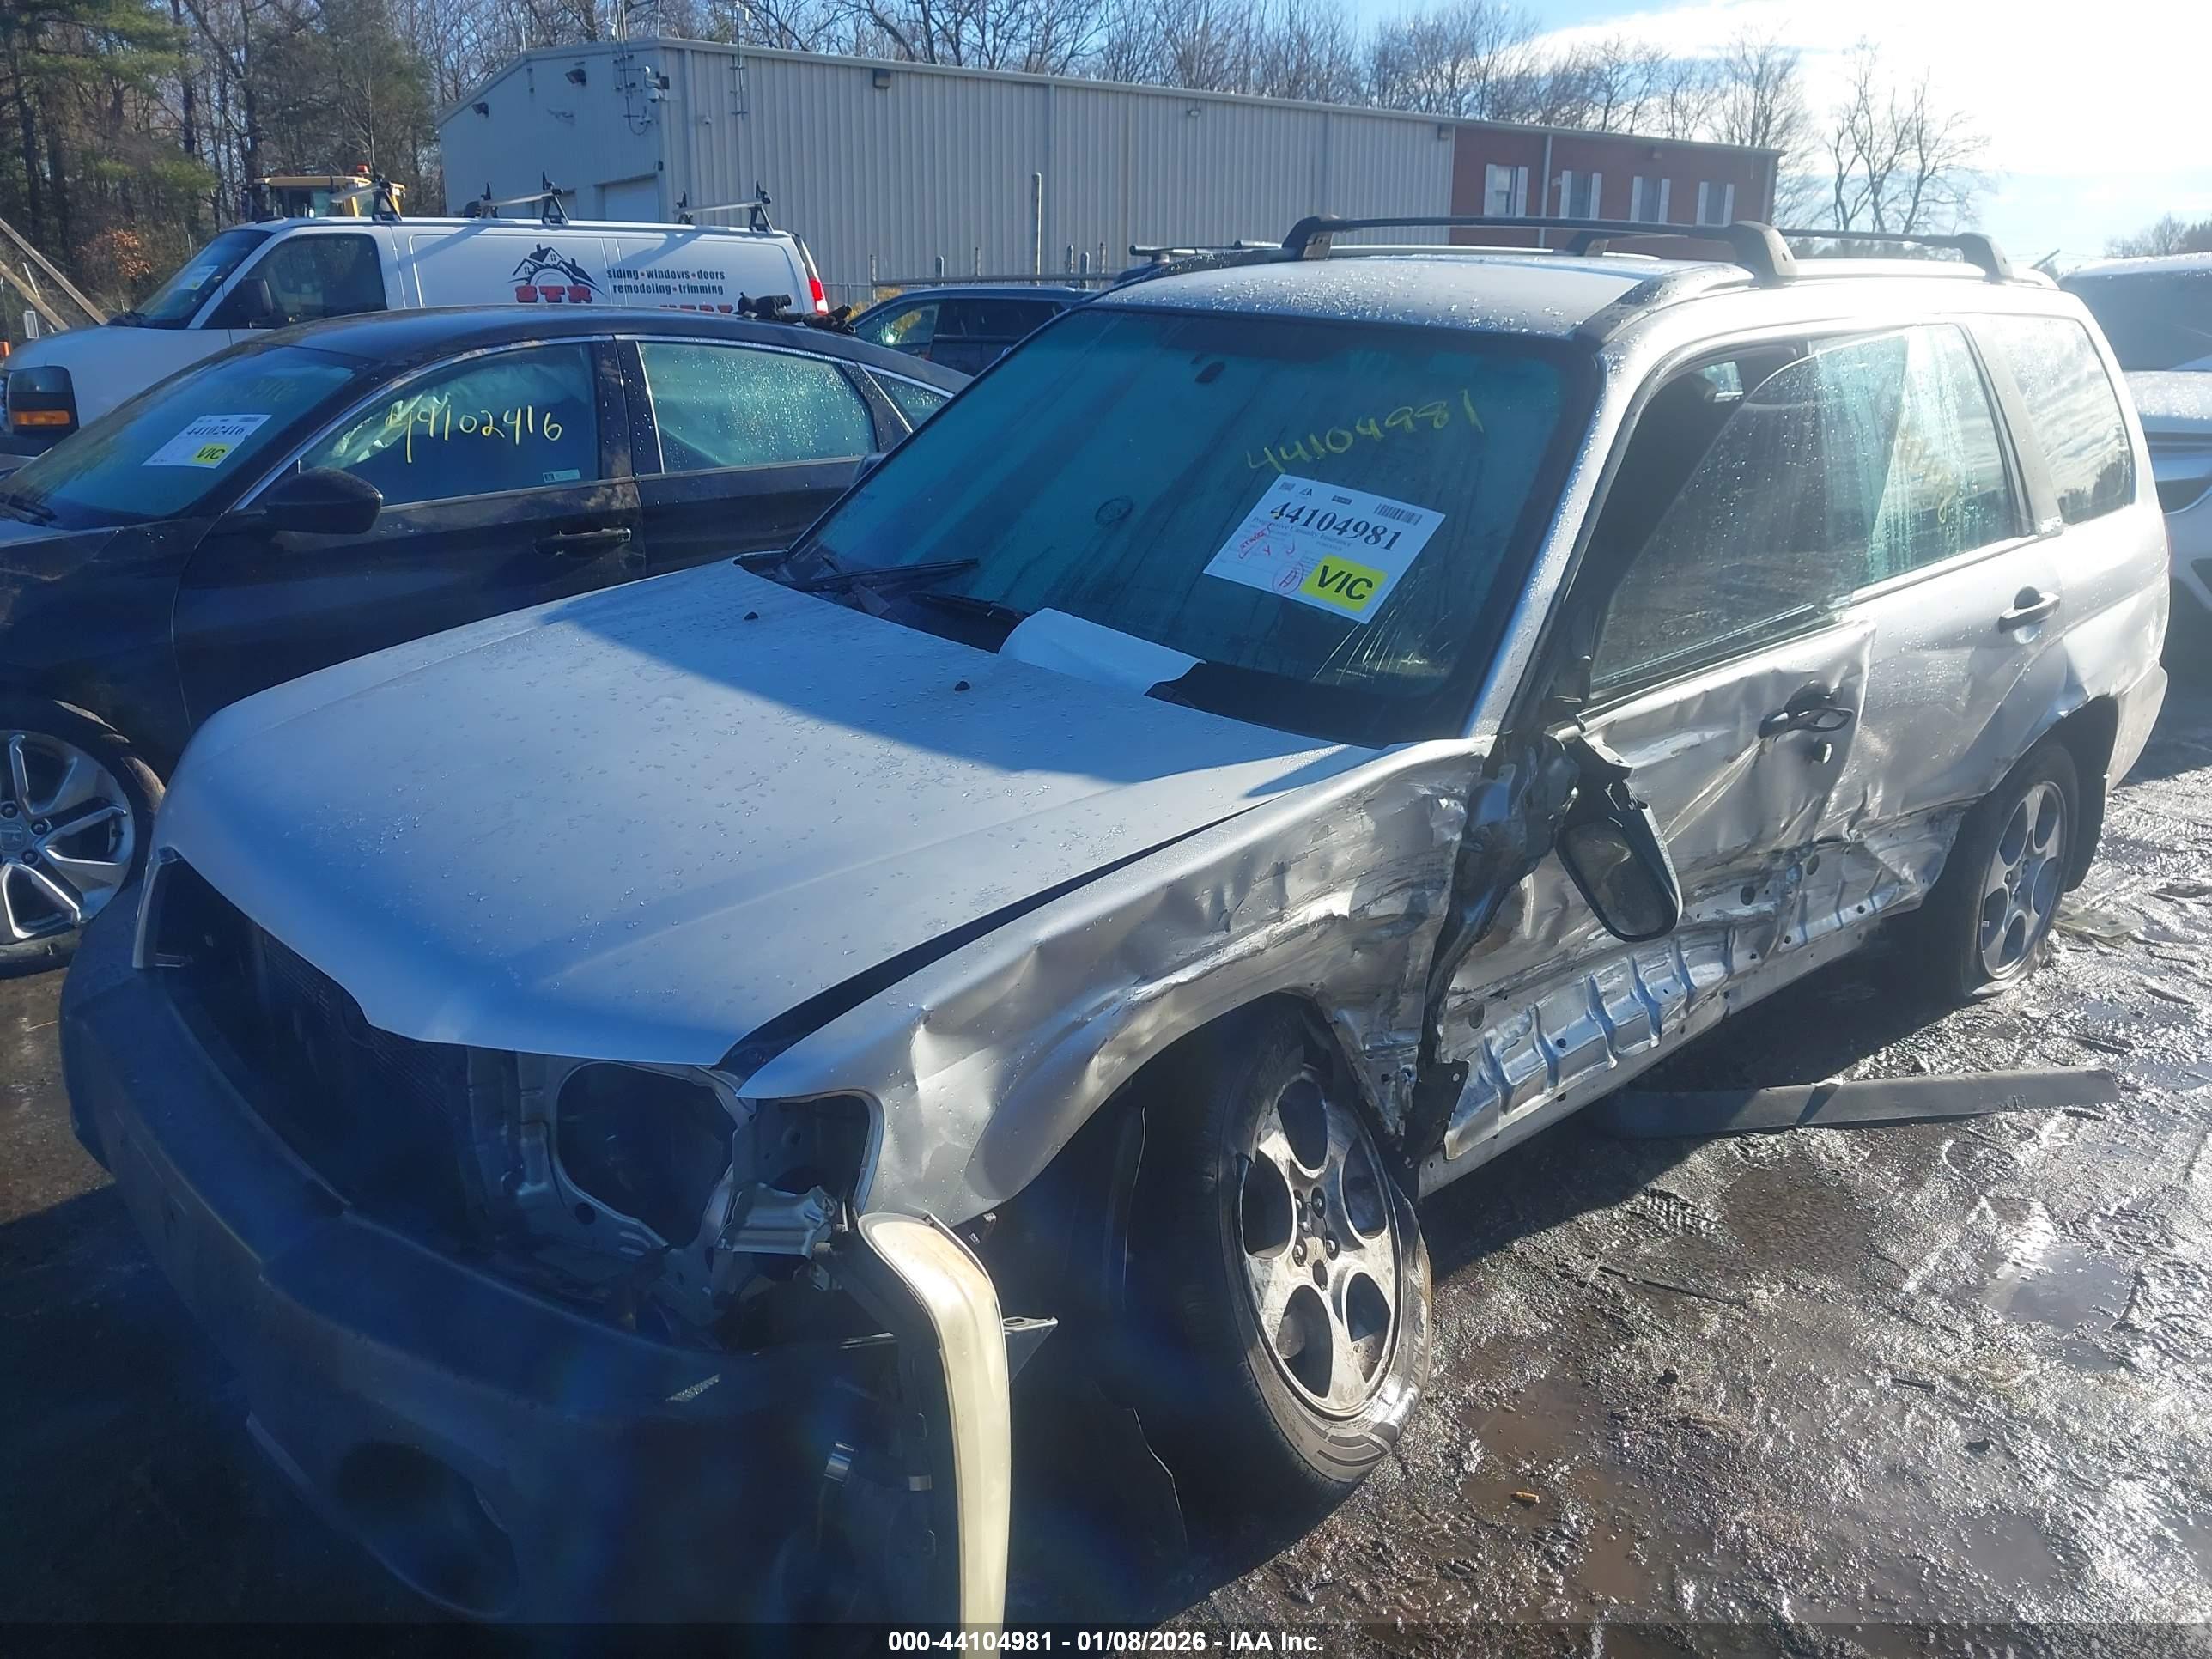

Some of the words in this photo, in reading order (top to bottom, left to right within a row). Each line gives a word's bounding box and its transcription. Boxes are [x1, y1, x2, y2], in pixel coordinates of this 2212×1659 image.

[606, 267, 639, 281] siding
[646, 267, 690, 280] windows
[696, 267, 726, 280] doors
[515, 285, 592, 303] STR
[613, 283, 672, 295] remodeling
[678, 283, 724, 295] trimming
[1247, 389, 1484, 473] 44104981
[197, 447, 226, 460] VIC
[1270, 501, 1402, 551] 44104981
[1317, 565, 1374, 600] VIC
